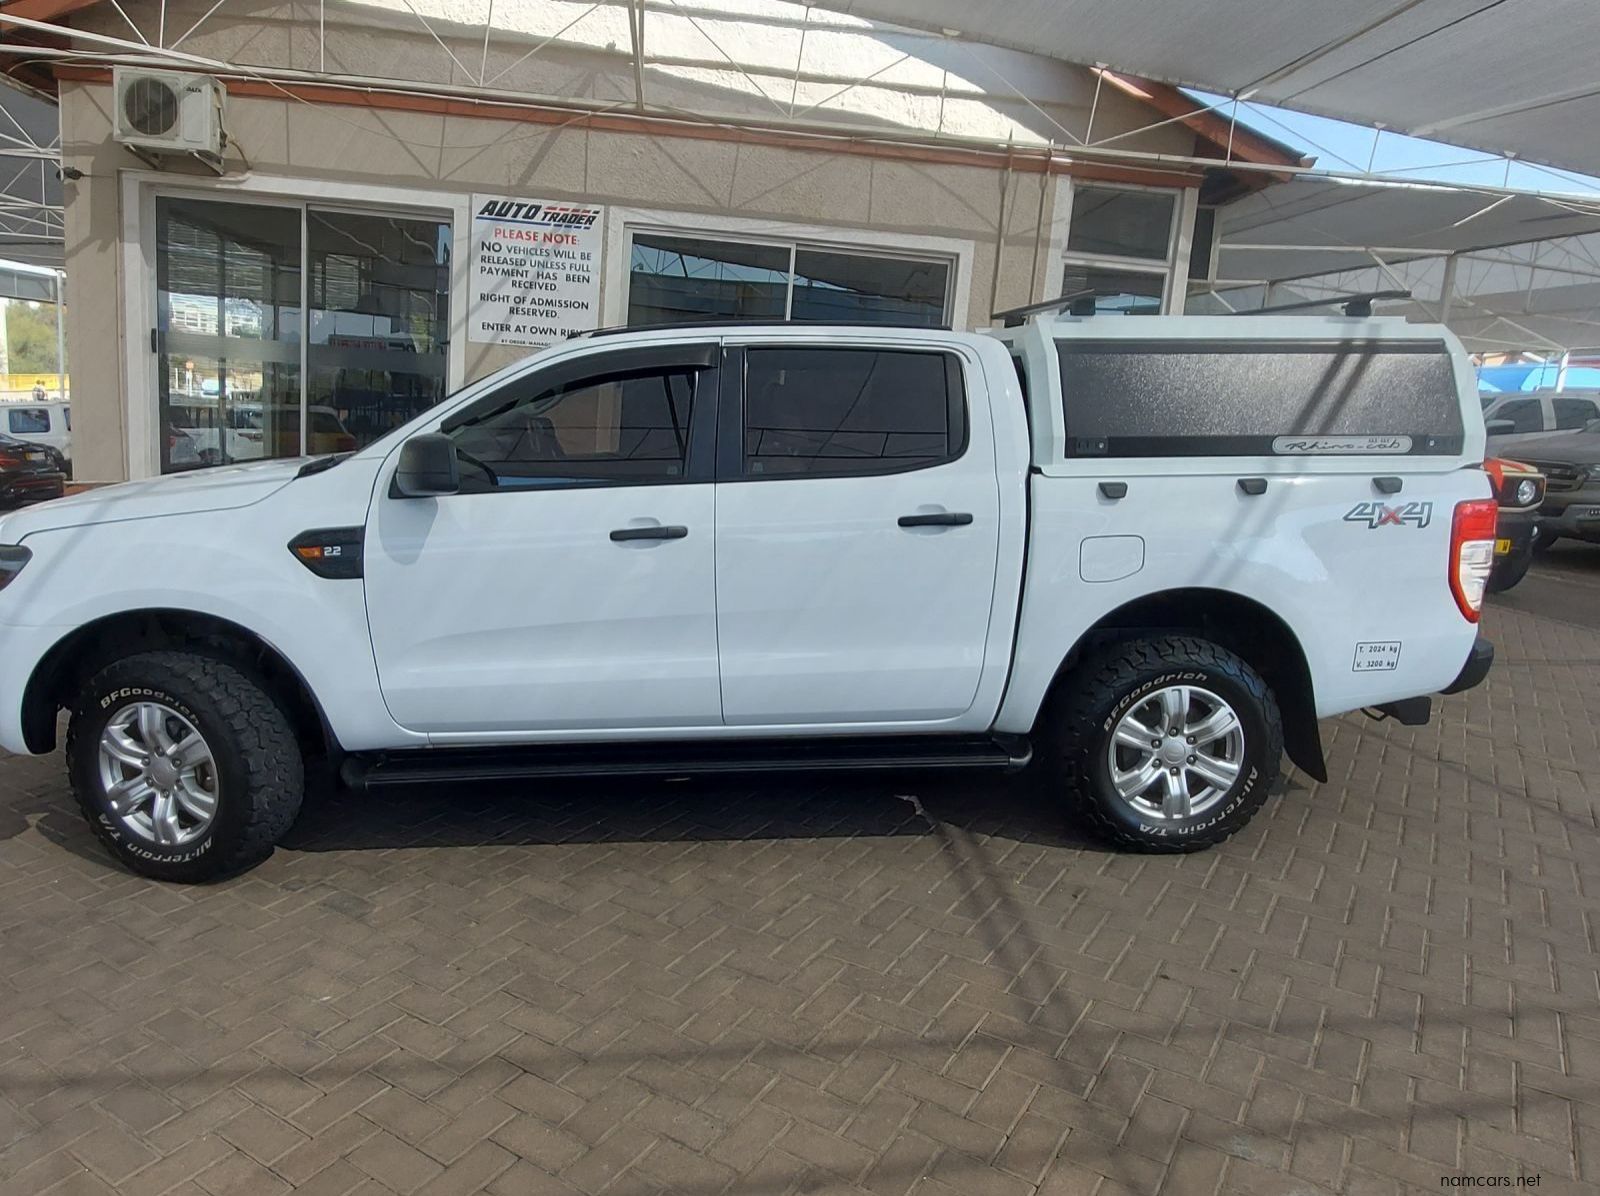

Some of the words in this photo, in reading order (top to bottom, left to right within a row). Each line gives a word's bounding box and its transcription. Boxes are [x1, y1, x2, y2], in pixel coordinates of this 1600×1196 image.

[478, 200, 542, 219] AUTO
[542, 211, 597, 225] TRADER
[494, 228, 539, 241] PLEASE
[543, 232, 580, 245] NOTE:
[481, 241, 502, 252] NO
[506, 245, 550, 257] VEHICLES
[553, 250, 577, 260] WILL
[580, 252, 592, 261] BE
[480, 255, 527, 267] RELEASED
[530, 259, 566, 271] UNLESS
[569, 263, 591, 273] FULL
[480, 266, 529, 278] PAYMENT
[536, 271, 558, 281] HAS
[565, 273, 590, 284] BEEN
[480, 293, 510, 304] RIGHT
[513, 296, 527, 305] OF
[530, 297, 589, 310] ADMISSION
[509, 306, 560, 319] RESERVED.
[481, 322, 511, 333] ENTER
[514, 325, 528, 334] AT
[529, 326, 557, 336] OWN
[1285, 439, 1401, 451] Rhino-cab
[1390, 645, 1398, 653] kg
[100, 687, 200, 725] BFGoodrich
[1103, 671, 1208, 731] BFGoodrich
[1178, 766, 1258, 835] All-Terrain
[98, 813, 121, 840] T/A
[1139, 823, 1168, 836] T/A
[127, 836, 212, 863] All-Terrain
